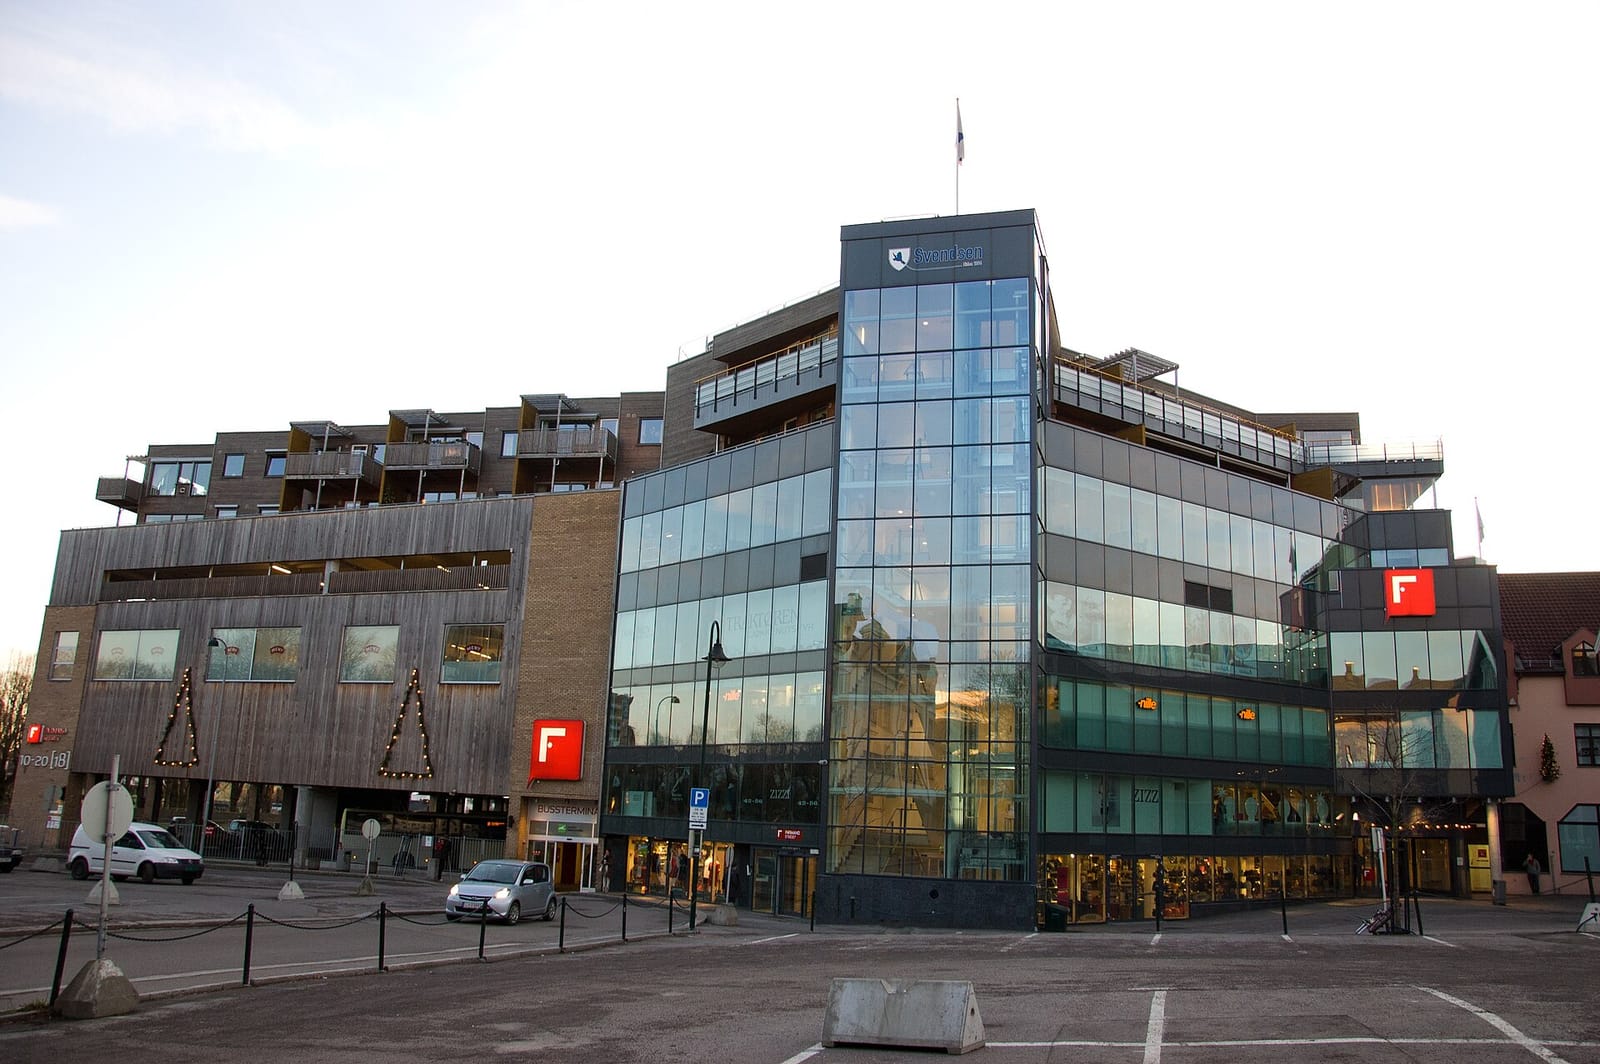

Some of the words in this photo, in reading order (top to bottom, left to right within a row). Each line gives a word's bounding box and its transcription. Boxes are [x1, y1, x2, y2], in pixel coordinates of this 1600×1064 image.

[914, 244, 983, 264] Svendsen
[19, 755, 49, 767] 10-20
[695, 791, 704, 805] P
